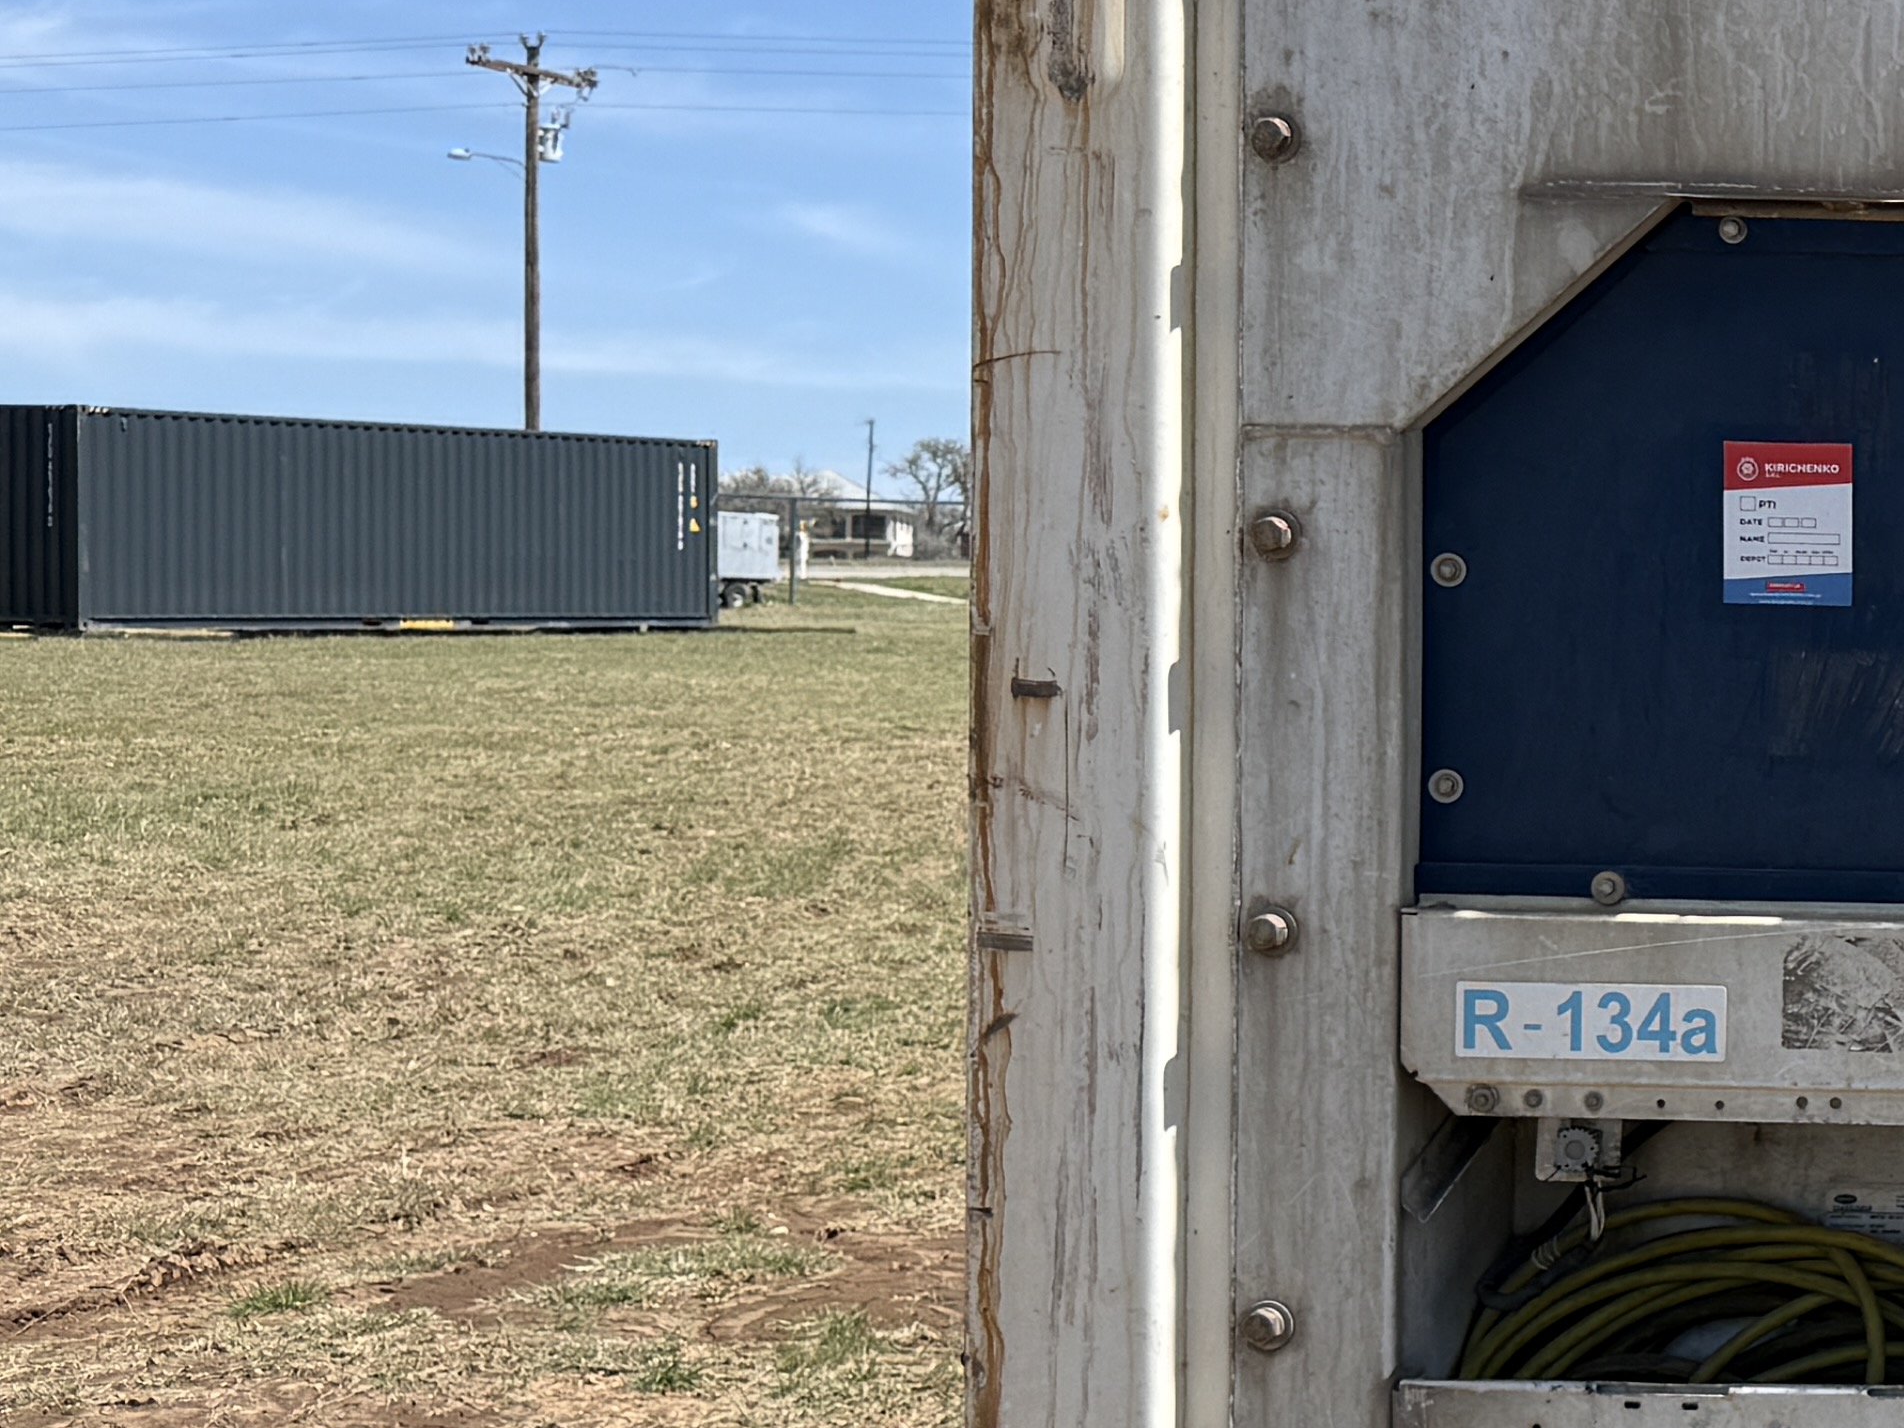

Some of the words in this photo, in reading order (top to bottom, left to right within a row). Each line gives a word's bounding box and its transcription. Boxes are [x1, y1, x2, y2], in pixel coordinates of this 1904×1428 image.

[1765, 463, 1840, 474] KIRICHENKO
[1758, 500, 1776, 509] PTI
[1739, 518, 1763, 526] DATE
